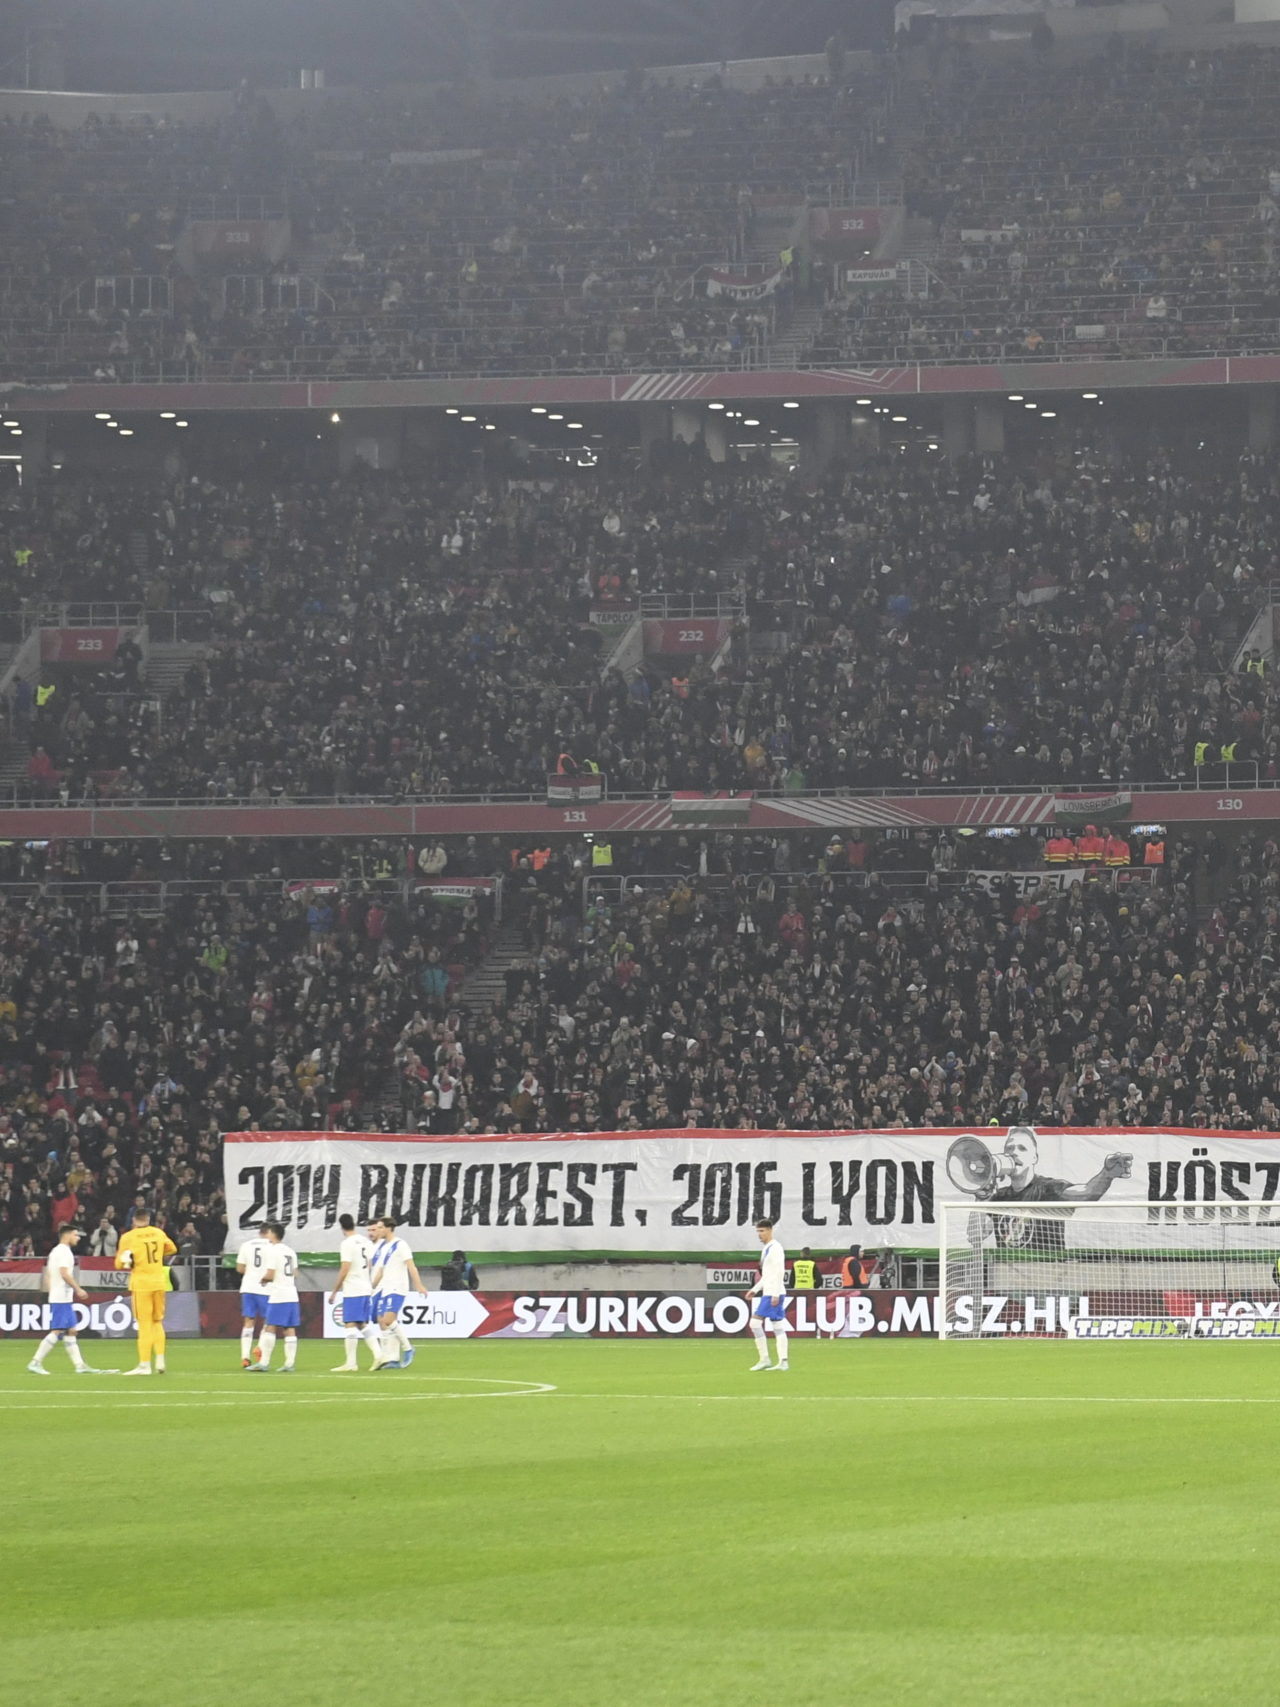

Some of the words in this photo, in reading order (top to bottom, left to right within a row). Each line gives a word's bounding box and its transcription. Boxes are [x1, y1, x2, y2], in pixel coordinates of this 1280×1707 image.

[841, 219, 864, 230] 332
[679, 630, 704, 642] 232
[77, 639, 103, 651] 233
[1217, 799, 1243, 810] 130
[564, 811, 588, 822] 131
[238, 1163, 341, 1230] 2014
[672, 1161, 782, 1227] 2016
[802, 1158, 935, 1227] LYON
[144, 1241, 158, 1264] 12
[254, 1247, 261, 1268] 6
